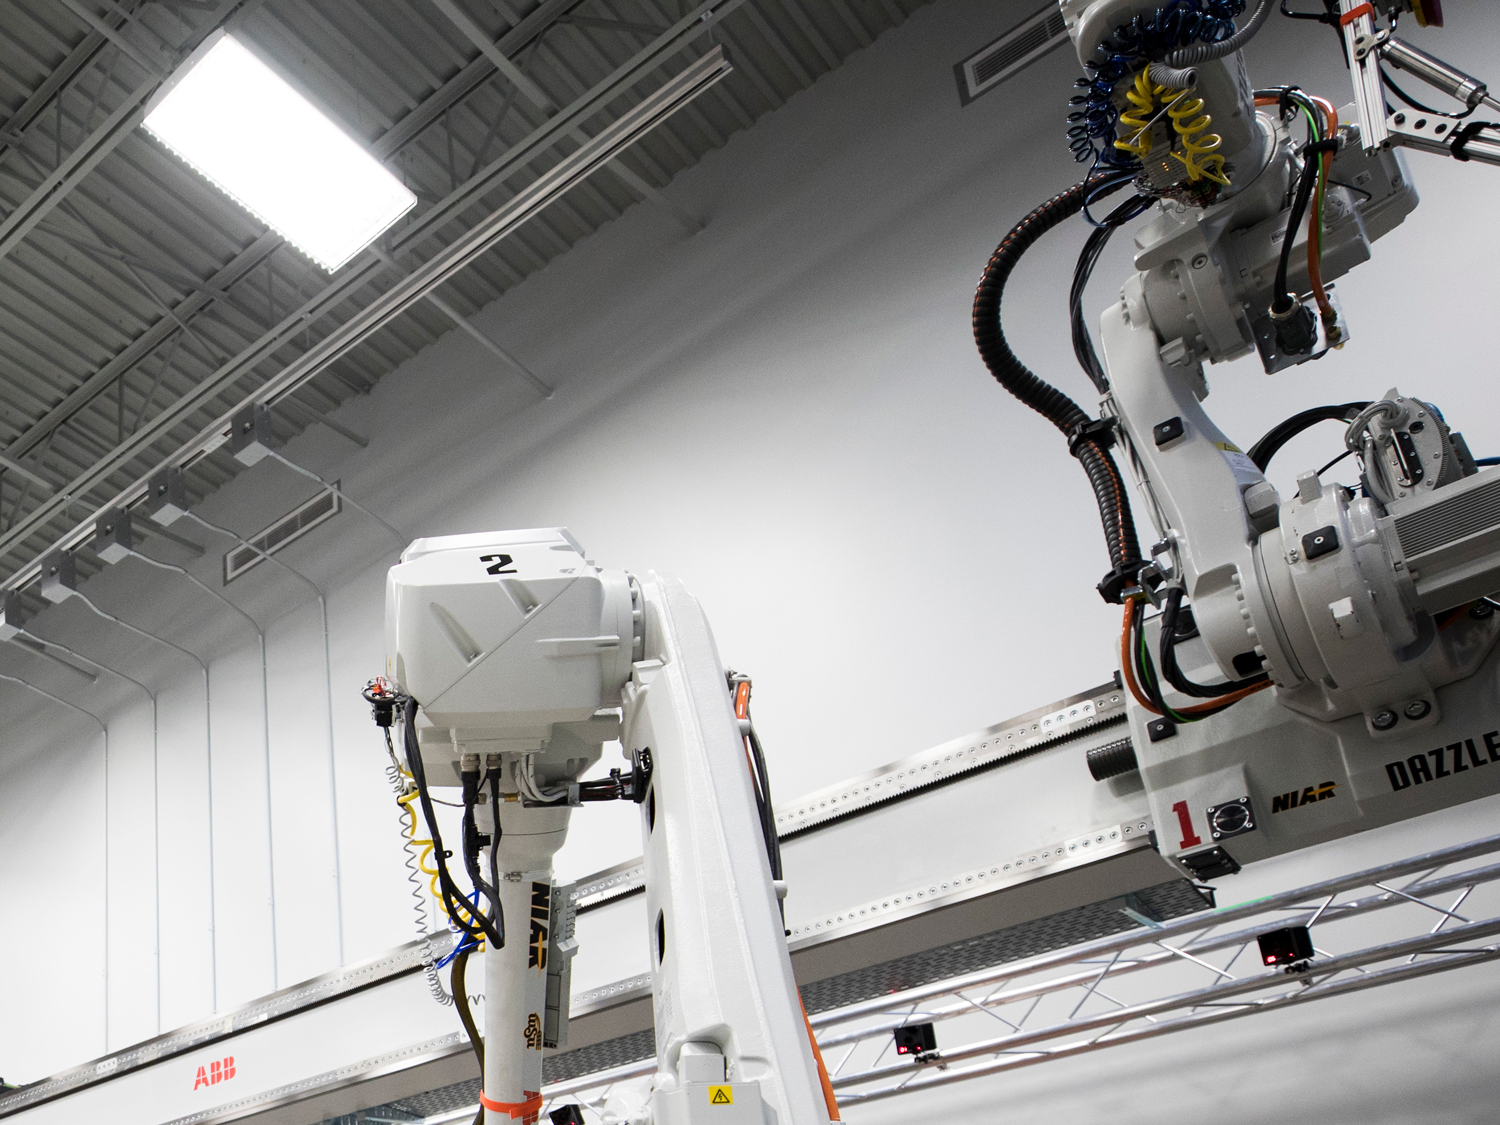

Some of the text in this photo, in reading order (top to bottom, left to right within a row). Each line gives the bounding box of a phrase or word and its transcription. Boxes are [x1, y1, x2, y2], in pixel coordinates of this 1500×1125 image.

[479, 554, 518, 575] 2
[1385, 731, 1500, 791] DAZZLE
[1272, 781, 1340, 814] NIAR
[1172, 800, 1201, 850] 1
[528, 881, 551, 974] NIAR
[193, 1056, 236, 1091] ABB
